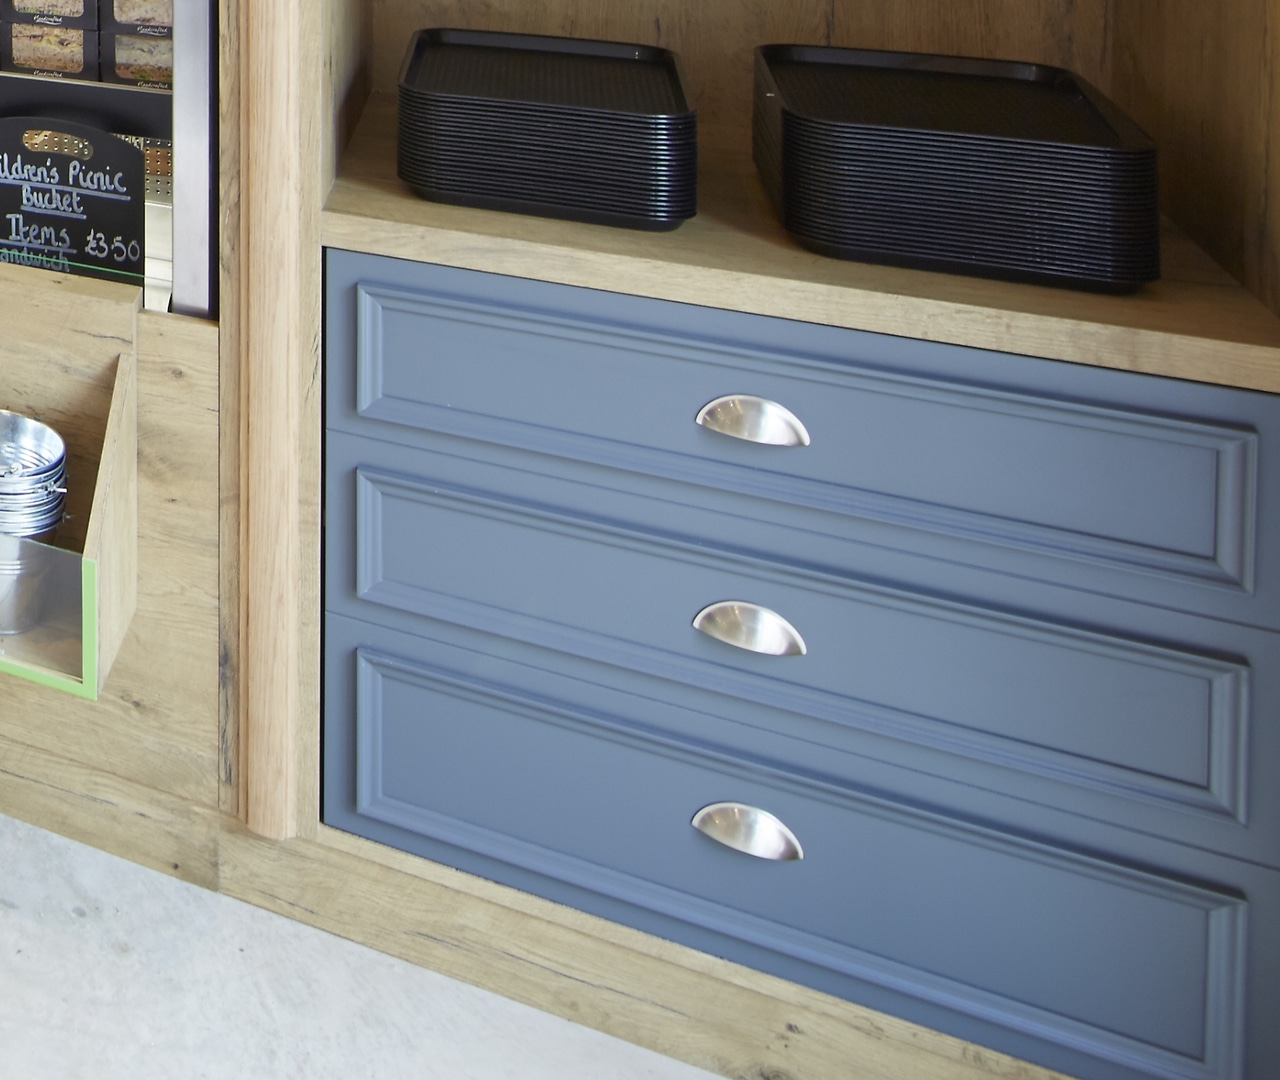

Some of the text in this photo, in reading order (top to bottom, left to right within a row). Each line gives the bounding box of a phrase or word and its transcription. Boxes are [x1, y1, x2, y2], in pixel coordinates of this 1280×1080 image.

[68, 160, 128, 194] Picnic
[22, 184, 85, 214] Bucket
[5, 213, 71, 249] Items
